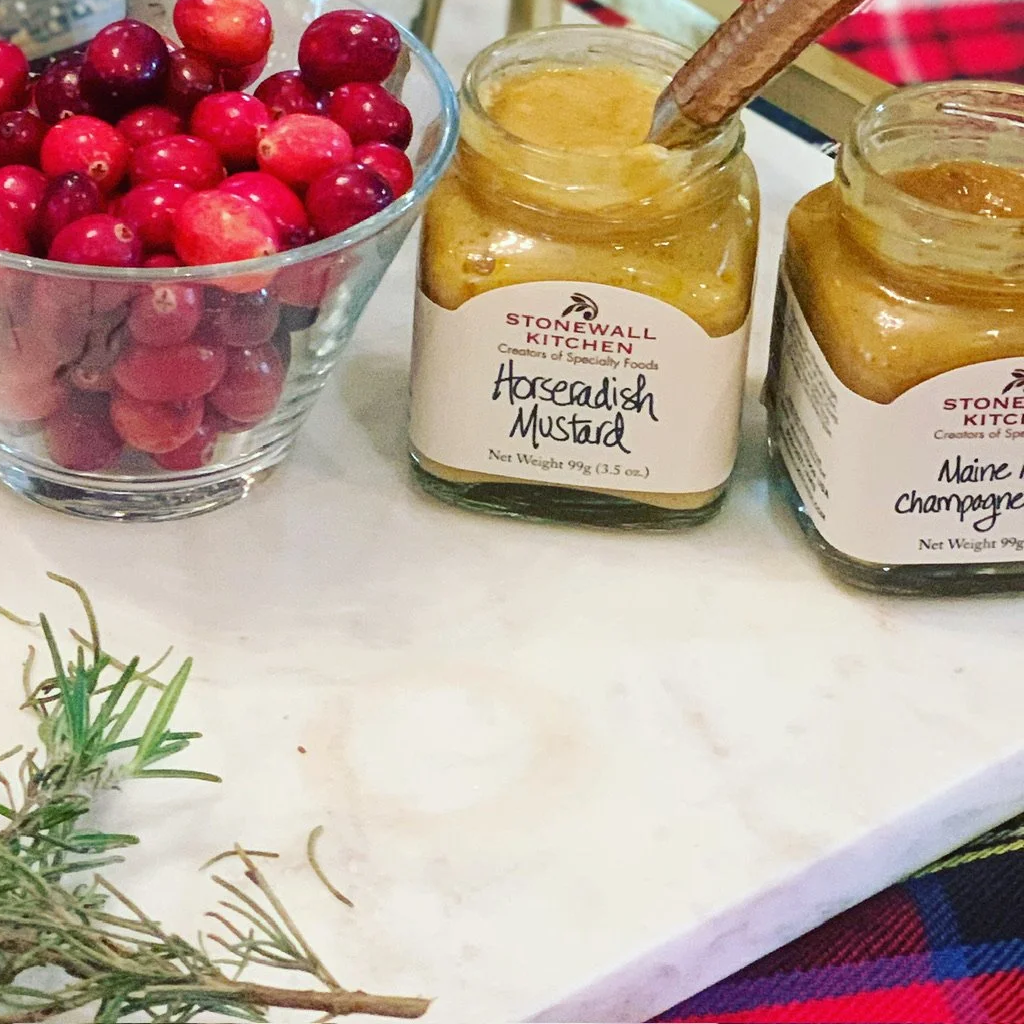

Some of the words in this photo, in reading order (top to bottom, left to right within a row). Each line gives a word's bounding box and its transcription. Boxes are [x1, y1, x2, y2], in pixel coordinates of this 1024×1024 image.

[506, 313, 657, 340] STONEWALL
[497, 343, 547, 359] Creators
[551, 351, 563, 361] of
[566, 352, 620, 369] Specialty
[623, 357, 659, 370] Foods
[526, 332, 633, 354] KITCHEN
[492, 359, 659, 422] Horseradish
[943, 396, 1024, 410] STONE
[509, 403, 631, 454] Mustard
[963, 413, 1024, 426] KITC
[934, 429, 985, 440] Creators
[988, 428, 1001, 439] of
[1005, 428, 1024, 441] Spe
[488, 449, 512, 463] Net
[516, 453, 563, 470] Weight
[568, 460, 592, 476] 99g
[595, 461, 620, 477] (3.5
[624, 466, 650, 479] oz.)
[937, 455, 1012, 484] Maine
[918, 538, 943, 551] Net
[947, 537, 997, 552] Weight
[1001, 538, 1024, 552] 99g
